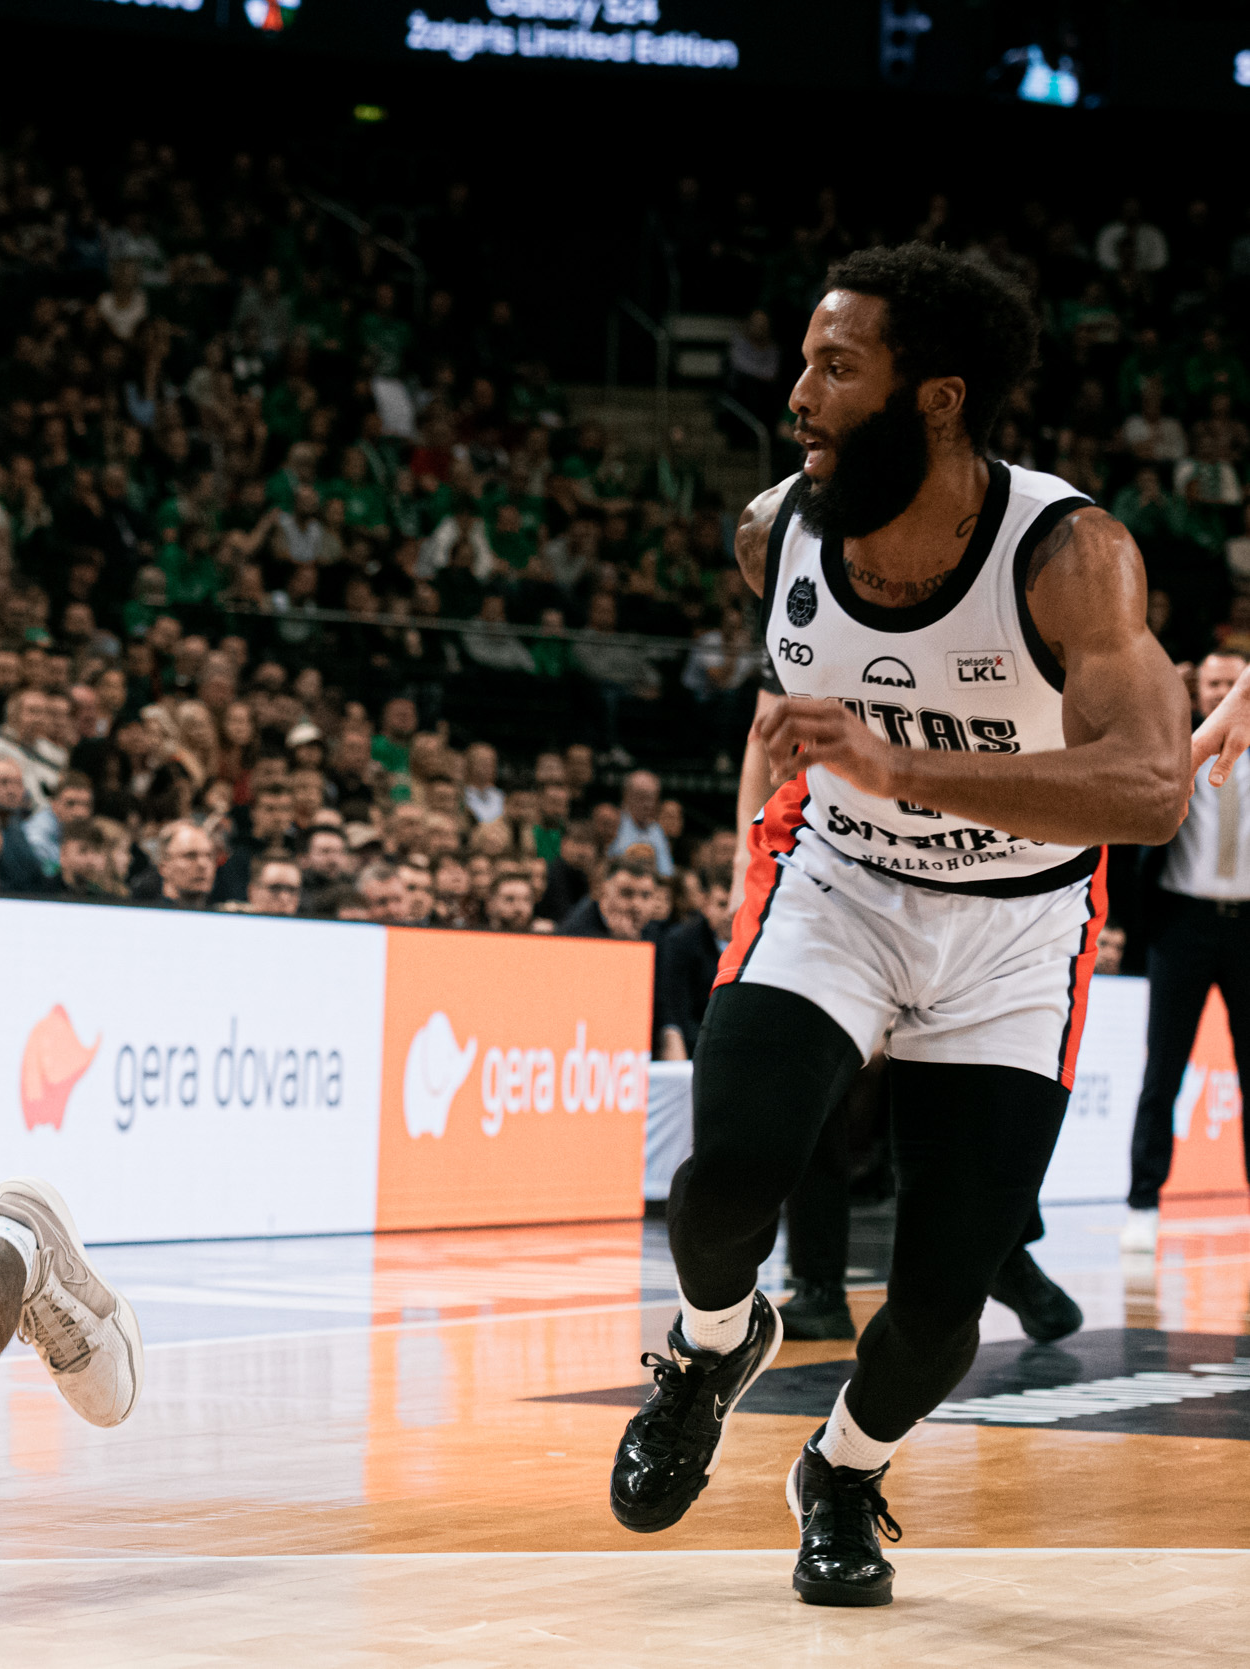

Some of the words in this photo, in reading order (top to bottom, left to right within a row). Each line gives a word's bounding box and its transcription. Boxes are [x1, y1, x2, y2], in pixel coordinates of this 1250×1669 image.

[518, 21, 632, 63] Limited
[635, 29, 738, 69] Edition
[957, 656, 993, 667] betsafe
[958, 666, 1007, 682] LKL
[114, 1044, 200, 1133] gera
[213, 1015, 344, 1108] dovana
[481, 1047, 556, 1138] gera
